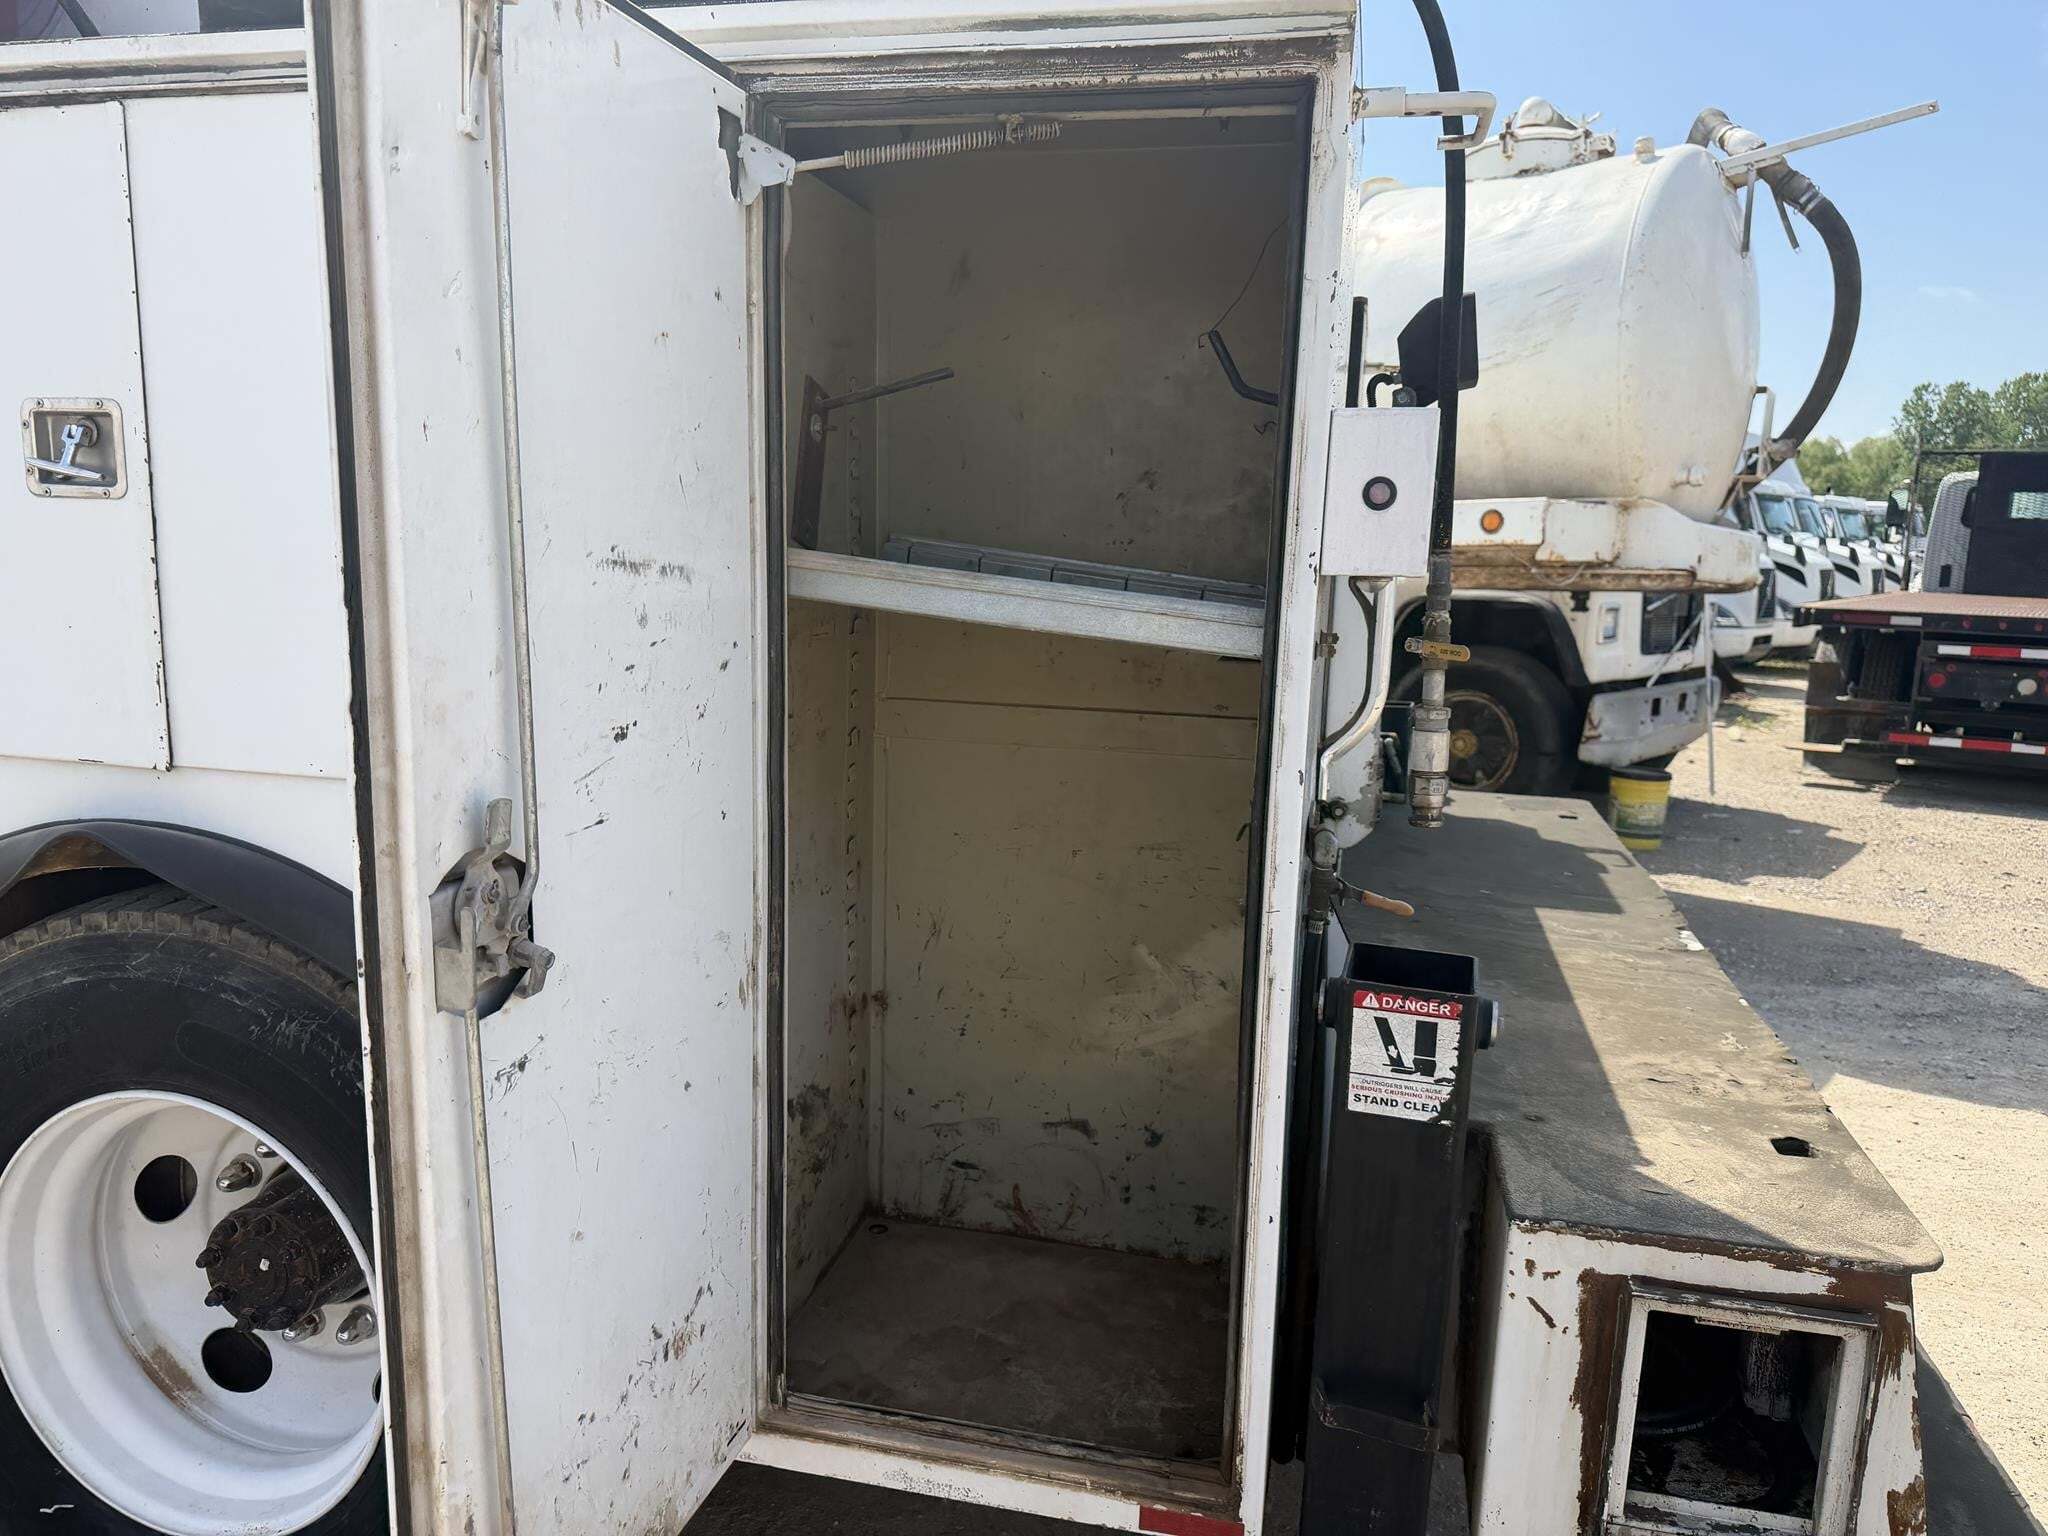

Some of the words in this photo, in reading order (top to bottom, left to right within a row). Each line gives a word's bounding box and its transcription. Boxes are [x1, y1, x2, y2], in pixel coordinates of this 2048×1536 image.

[1382, 997, 1451, 1016] DANGER
[1351, 1084, 1382, 1093] SERIOUS
[1384, 1089, 1423, 1099] CRUSHING
[1425, 1094, 1448, 1102] INJUR
[1361, 1079, 1402, 1090] OUTRIGGERS
[1404, 1084, 1418, 1092] WILL
[1420, 1087, 1442, 1095] CAUSE
[1353, 1093, 1399, 1107] STAND
[1403, 1101, 1440, 1113] CLEA
